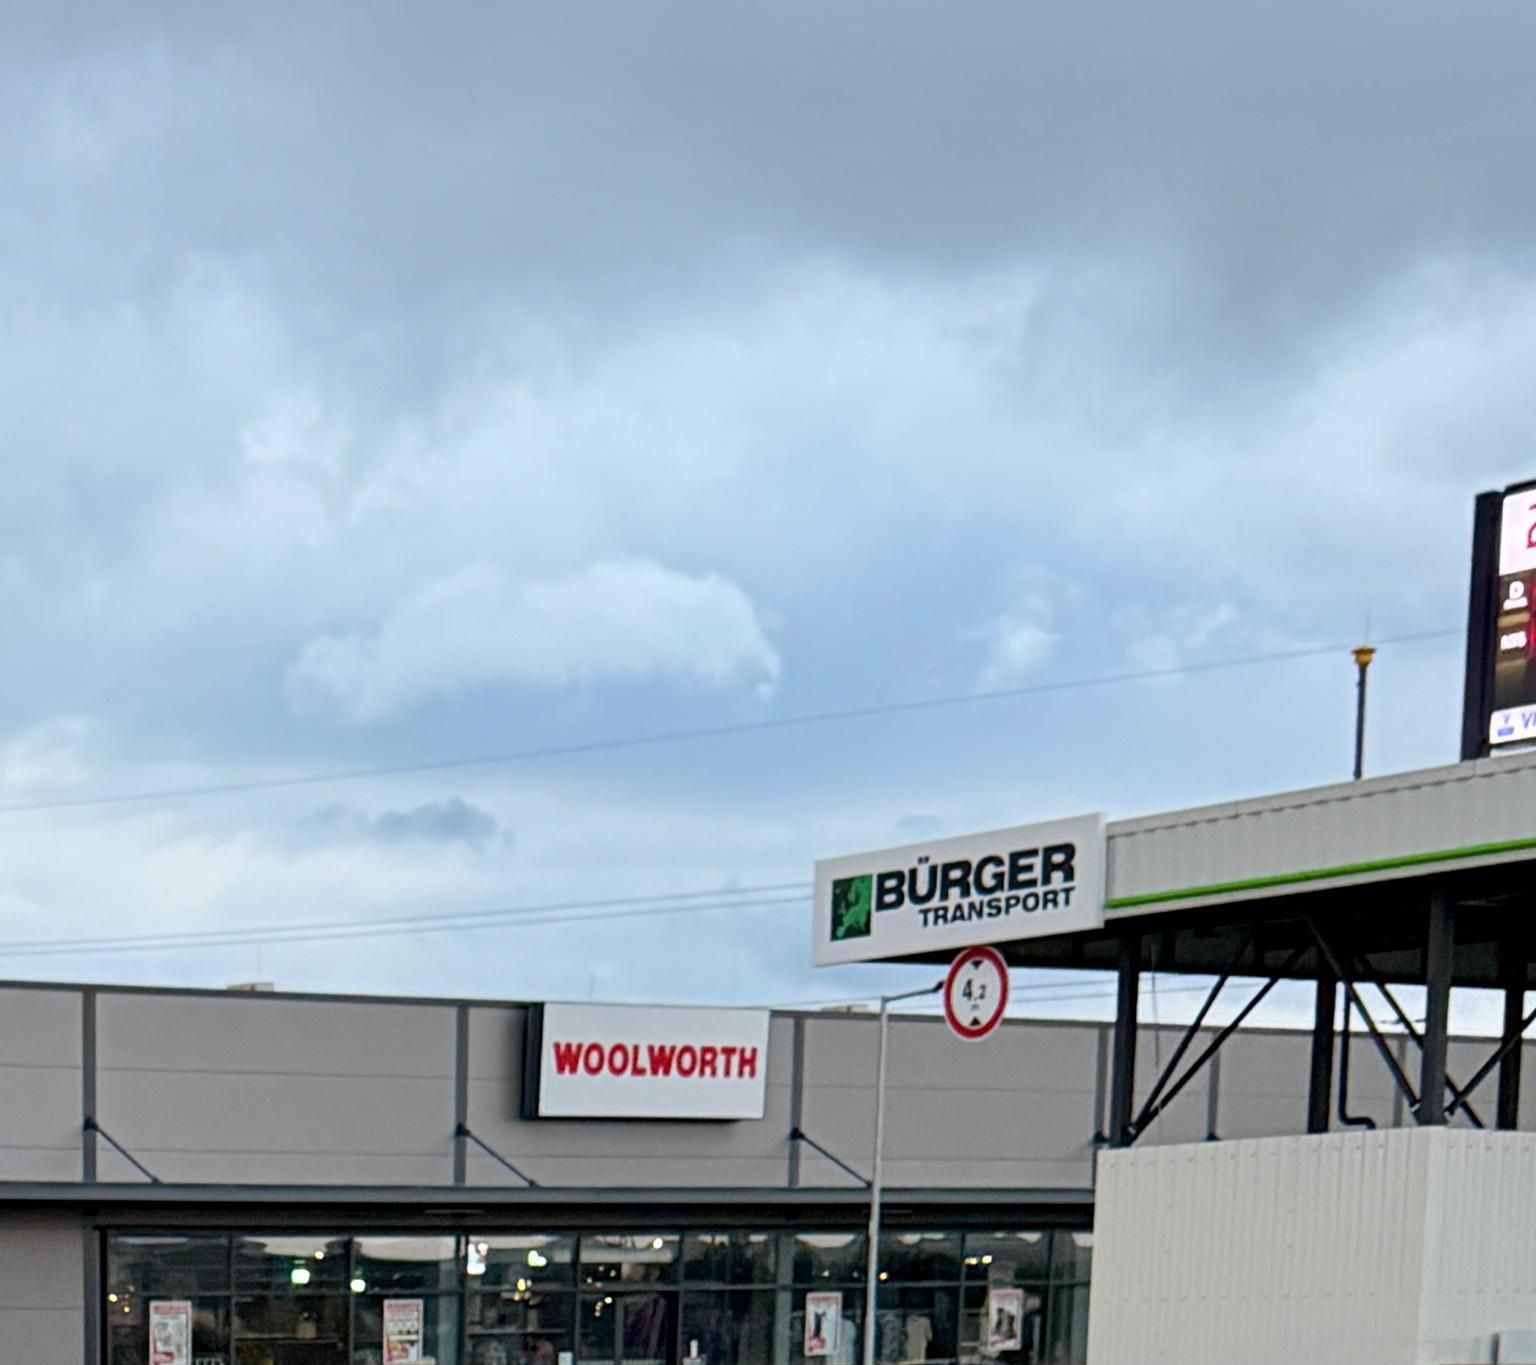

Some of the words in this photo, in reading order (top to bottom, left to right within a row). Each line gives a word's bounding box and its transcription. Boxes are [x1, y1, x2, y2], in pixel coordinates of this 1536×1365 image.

[875, 843, 1076, 912] BÜRGER
[918, 886, 1076, 928] TRANSPORT
[553, 1042, 758, 1079] WOOLWORTH
